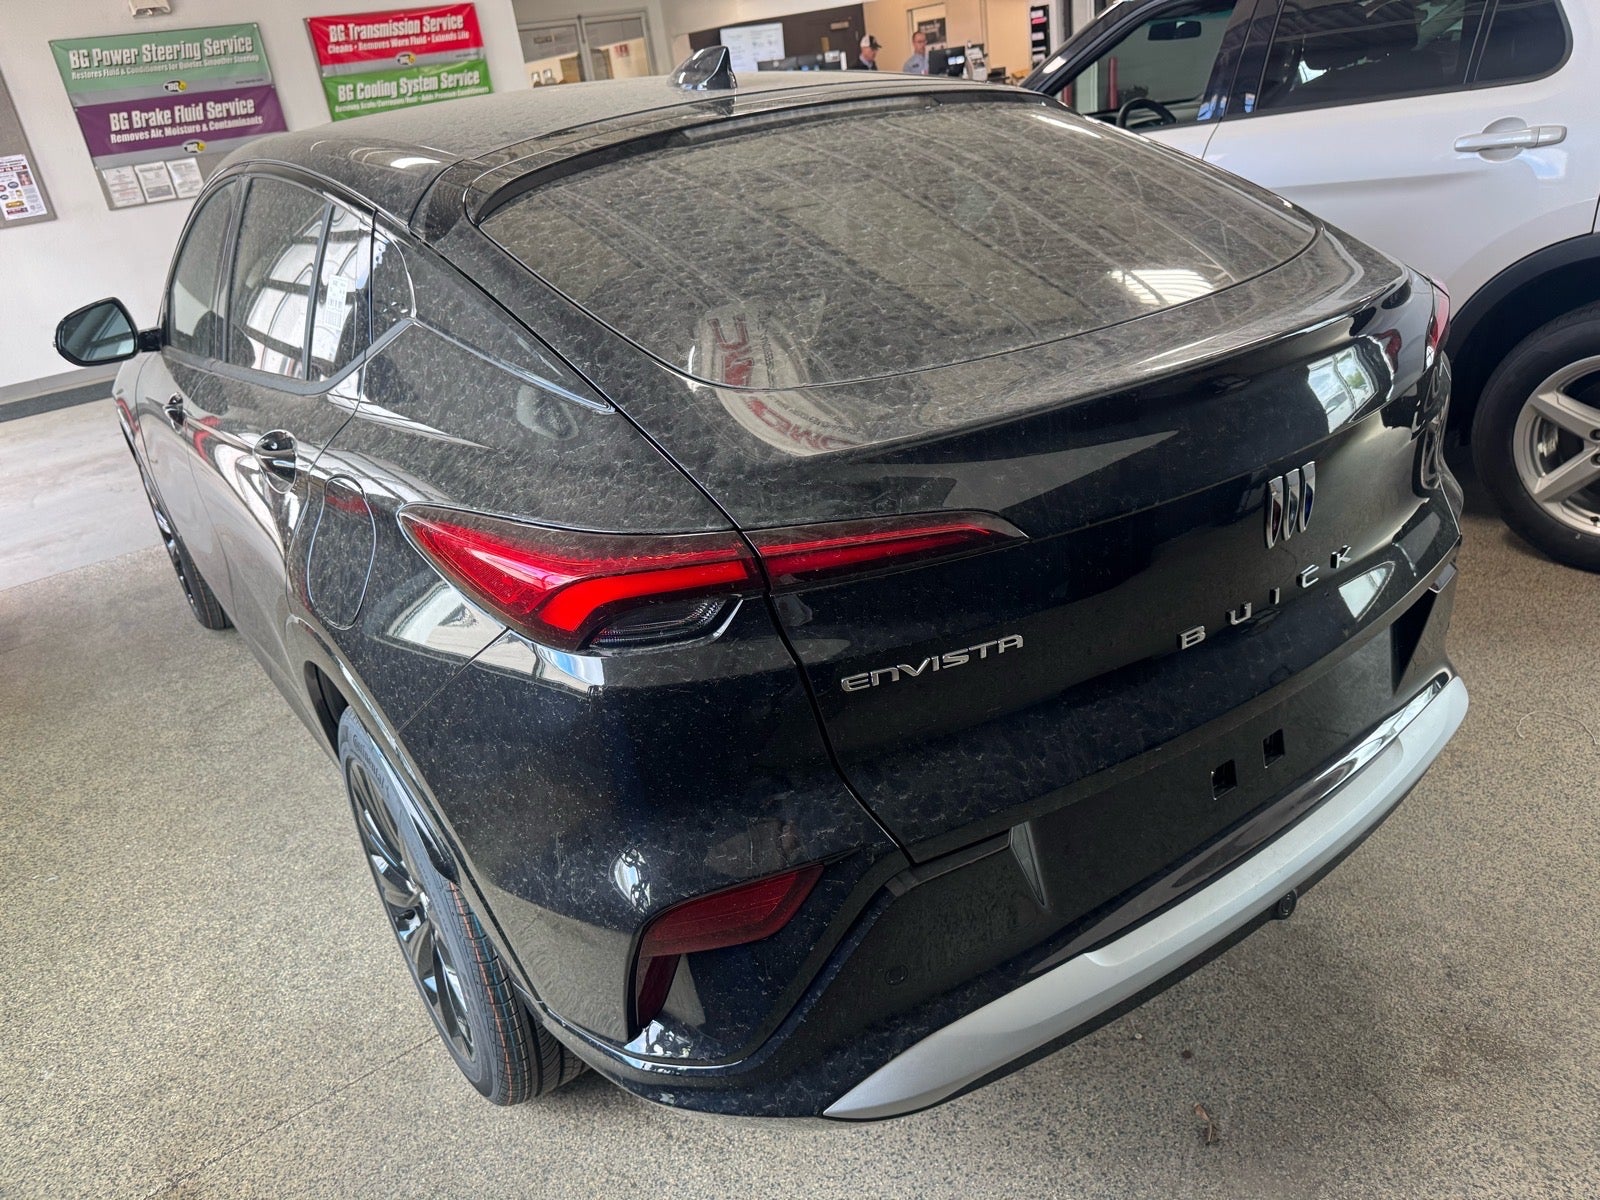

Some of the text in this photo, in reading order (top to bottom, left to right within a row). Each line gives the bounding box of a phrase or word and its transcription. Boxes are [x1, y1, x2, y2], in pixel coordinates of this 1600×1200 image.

[329, 14, 464, 43] BG Transmission Service
[69, 35, 254, 70] BG Power Steering Service
[72, 70, 102, 80] Restores
[338, 69, 480, 102] BG Cooling System Service
[109, 97, 255, 132] BG Brake Fluid Service
[110, 131, 150, 144] Removes
[164, 124, 201, 137] Moisture
[1177, 544, 1352, 650] BUICK
[840, 634, 1024, 692] ENVISTA
